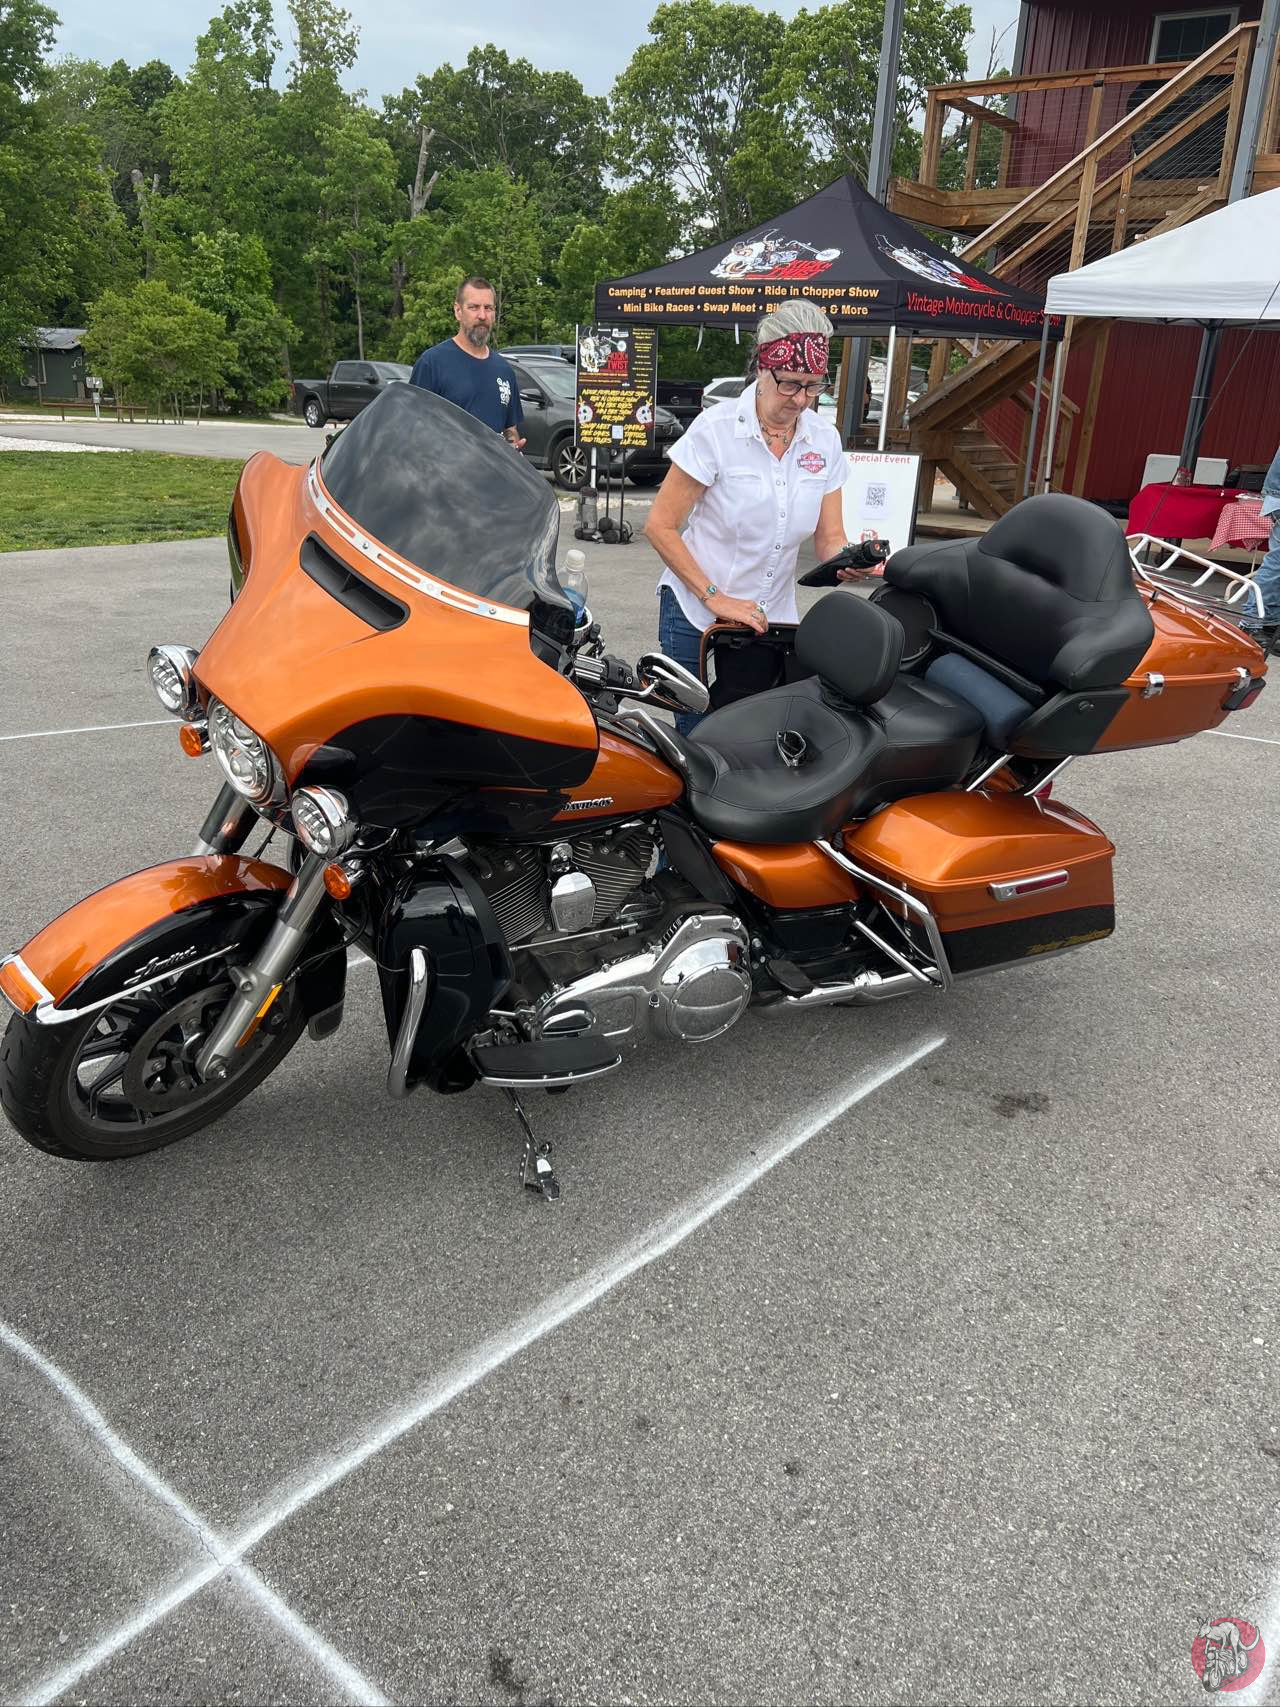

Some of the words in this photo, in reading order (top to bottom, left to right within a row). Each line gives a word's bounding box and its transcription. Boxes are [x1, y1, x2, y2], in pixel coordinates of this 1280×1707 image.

[608, 287, 647, 298] Camping
[655, 286, 696, 296] Featured
[698, 285, 726, 296] Guest
[728, 285, 755, 296] Show
[764, 286, 788, 296] Ride
[790, 286, 800, 296] in
[802, 286, 846, 299] Chopper
[848, 287, 880, 298] Show
[623, 303, 642, 313] Mini
[644, 303, 664, 312] Bike
[666, 303, 695, 312] Races
[703, 302, 730, 314] Swap
[732, 302, 756, 312] Meet
[830, 305, 838, 314] &
[842, 304, 869, 315] More
[907, 291, 944, 317] Vintage
[945, 295, 995, 320] Motorcycle
[996, 302, 1003, 320] &
[1005, 303, 1040, 326] Chopper
[608, 361, 628, 370] TWIST
[849, 453, 882, 463] Special
[884, 454, 912, 464] Event
